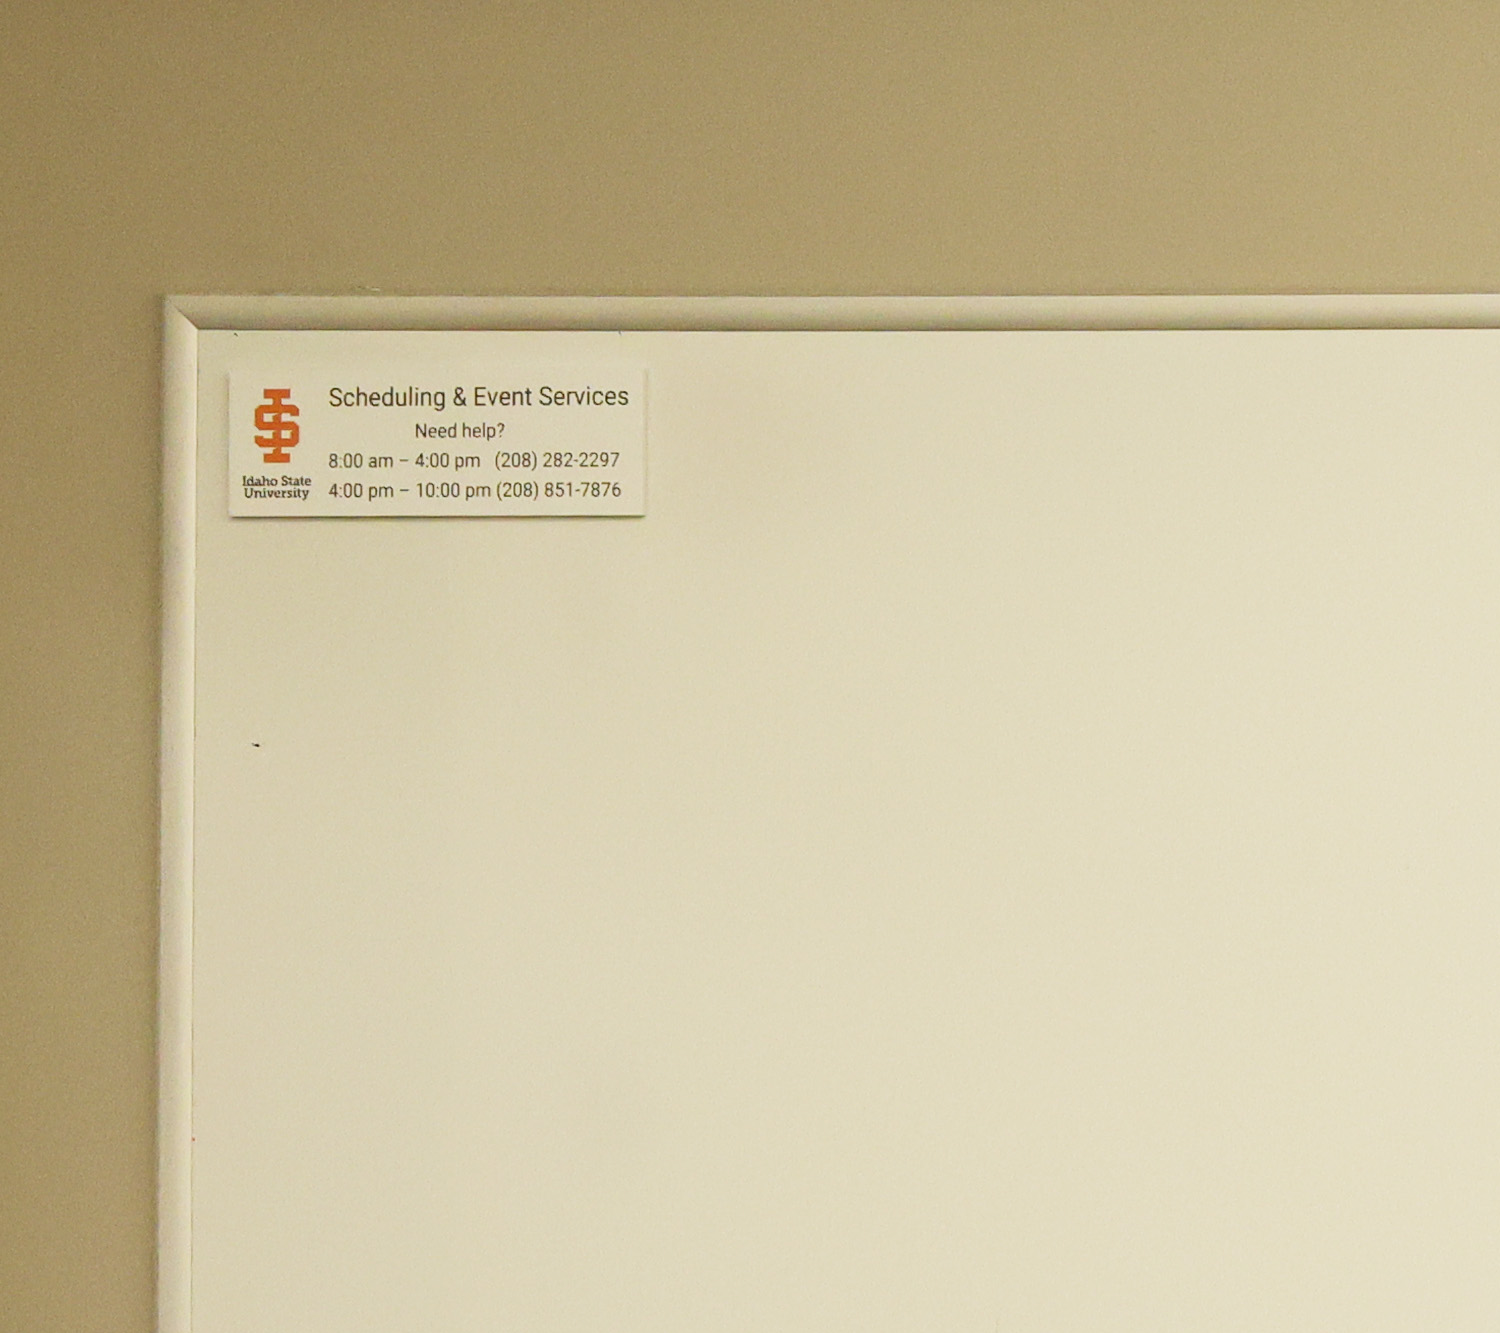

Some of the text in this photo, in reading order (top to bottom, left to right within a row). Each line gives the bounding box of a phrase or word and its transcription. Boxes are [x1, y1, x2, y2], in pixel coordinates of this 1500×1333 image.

[329, 386, 628, 411] Scheduling & Event Services
[416, 422, 505, 441] Need help?
[329, 453, 363, 468] 8:00
[369, 457, 393, 468] am
[415, 453, 449, 468] 4:00
[455, 456, 480, 471] pm
[495, 451, 537, 471] (208)
[543, 452, 619, 467] 282-2297
[243, 475, 311, 486] Idaho State
[244, 488, 309, 501] University
[329, 483, 362, 498] 4:00
[369, 486, 393, 501] pm
[417, 482, 457, 497] 10:00
[466, 486, 491, 502] pm
[497, 481, 538, 501] (208)
[545, 482, 621, 497] 851-7876
